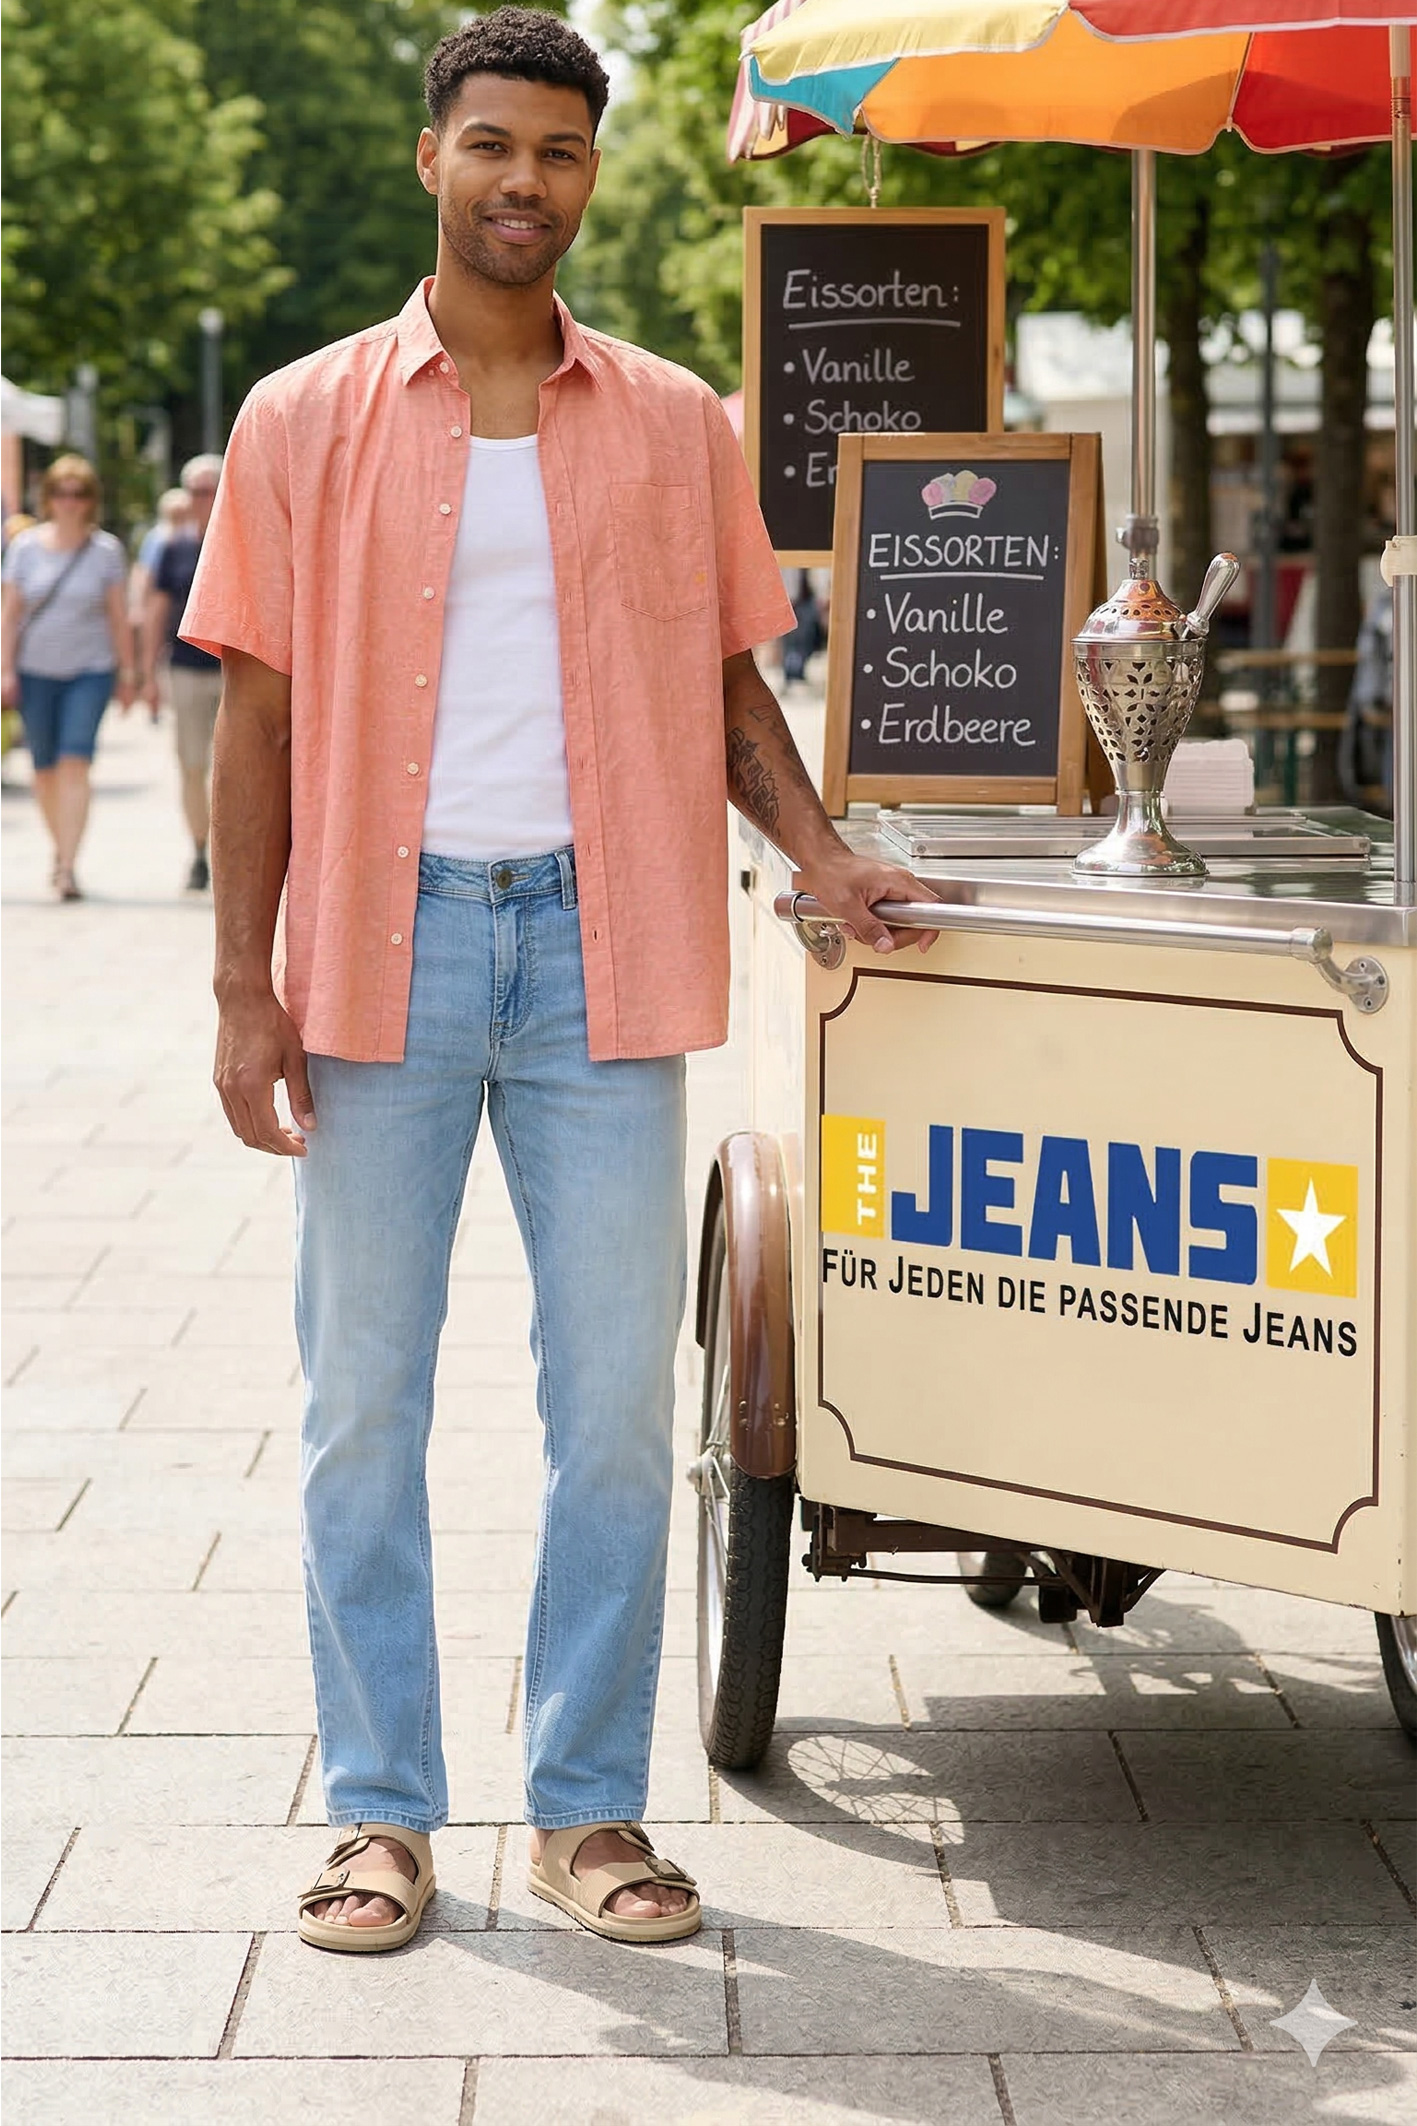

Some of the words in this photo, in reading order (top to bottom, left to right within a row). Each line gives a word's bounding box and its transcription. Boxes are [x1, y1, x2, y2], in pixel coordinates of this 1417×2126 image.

[783, 269, 960, 309] Eissorten:
[802, 348, 915, 384] Vanille
[804, 399, 922, 434] Schoko
[868, 533, 1060, 568] EISSORTEN:
[884, 591, 1008, 634] Vanille
[881, 646, 1017, 688] Schoko
[879, 703, 1036, 746] Erdbeere
[856, 1132, 877, 1226] THE
[891, 1124, 1258, 1286] JEANS
[822, 1249, 877, 1290] FÜR
[888, 1256, 984, 1304] JEDEN
[999, 1277, 1046, 1314] DIE
[1060, 1284, 1229, 1339] PASSENDE
[1243, 1302, 1358, 1358] JEANS
